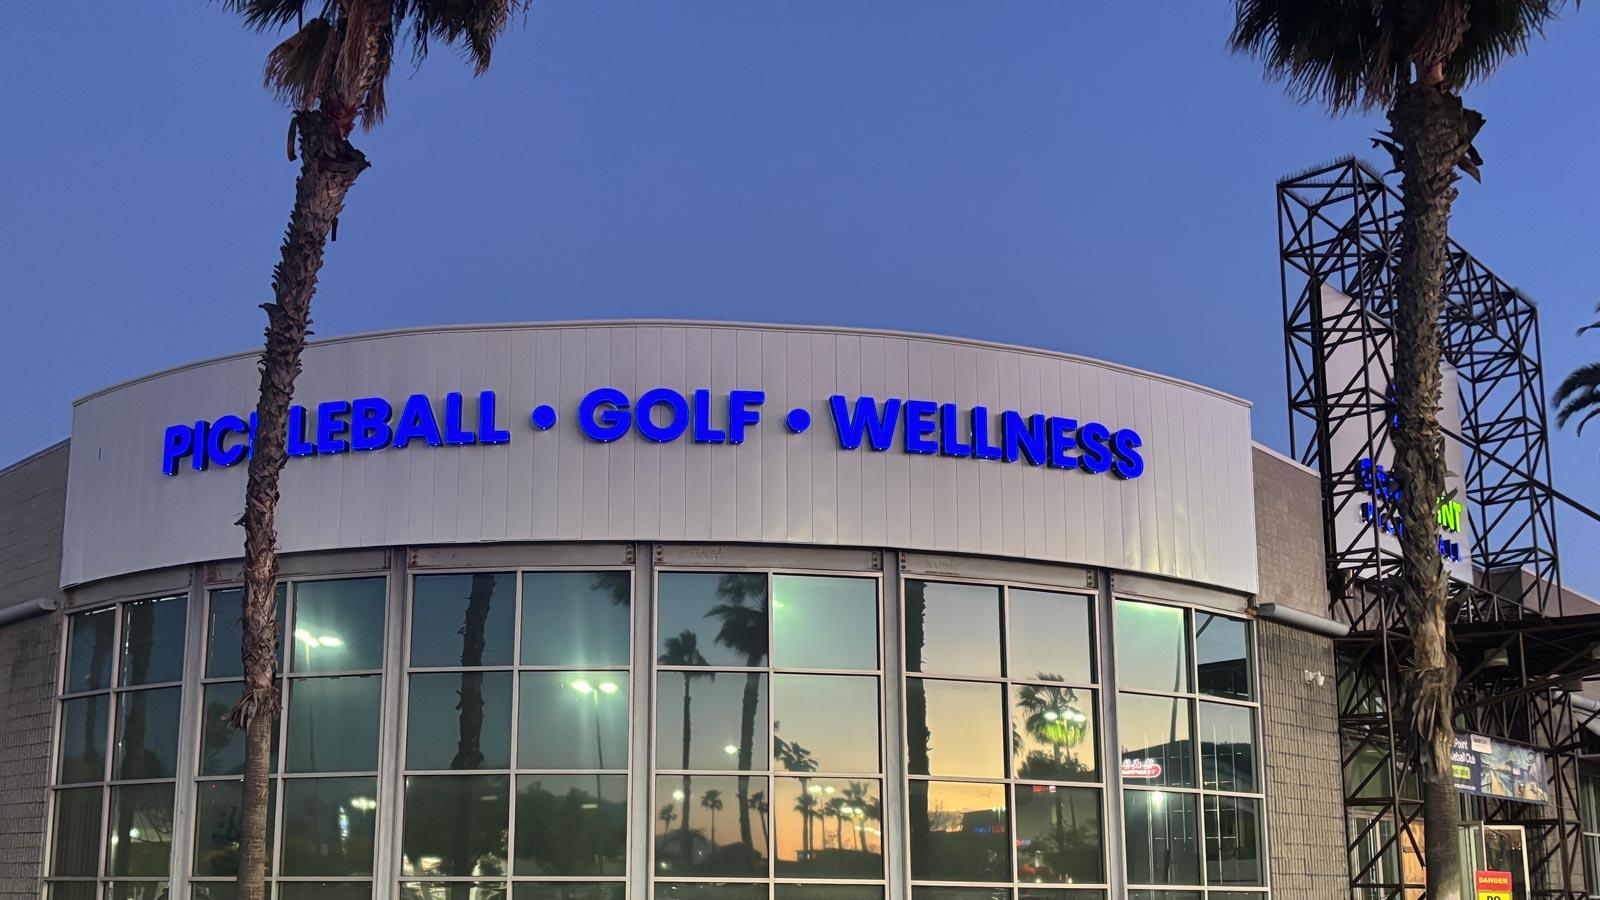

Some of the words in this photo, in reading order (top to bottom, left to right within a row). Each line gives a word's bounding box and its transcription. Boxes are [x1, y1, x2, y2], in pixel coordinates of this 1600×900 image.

[162, 390, 510, 477] PICLEBALL
[578, 387, 765, 444] GOLF
[829, 394, 1144, 480] WELLNESS
[1466, 752, 1476, 764] Club
[1478, 876, 1509, 885] DANGER
